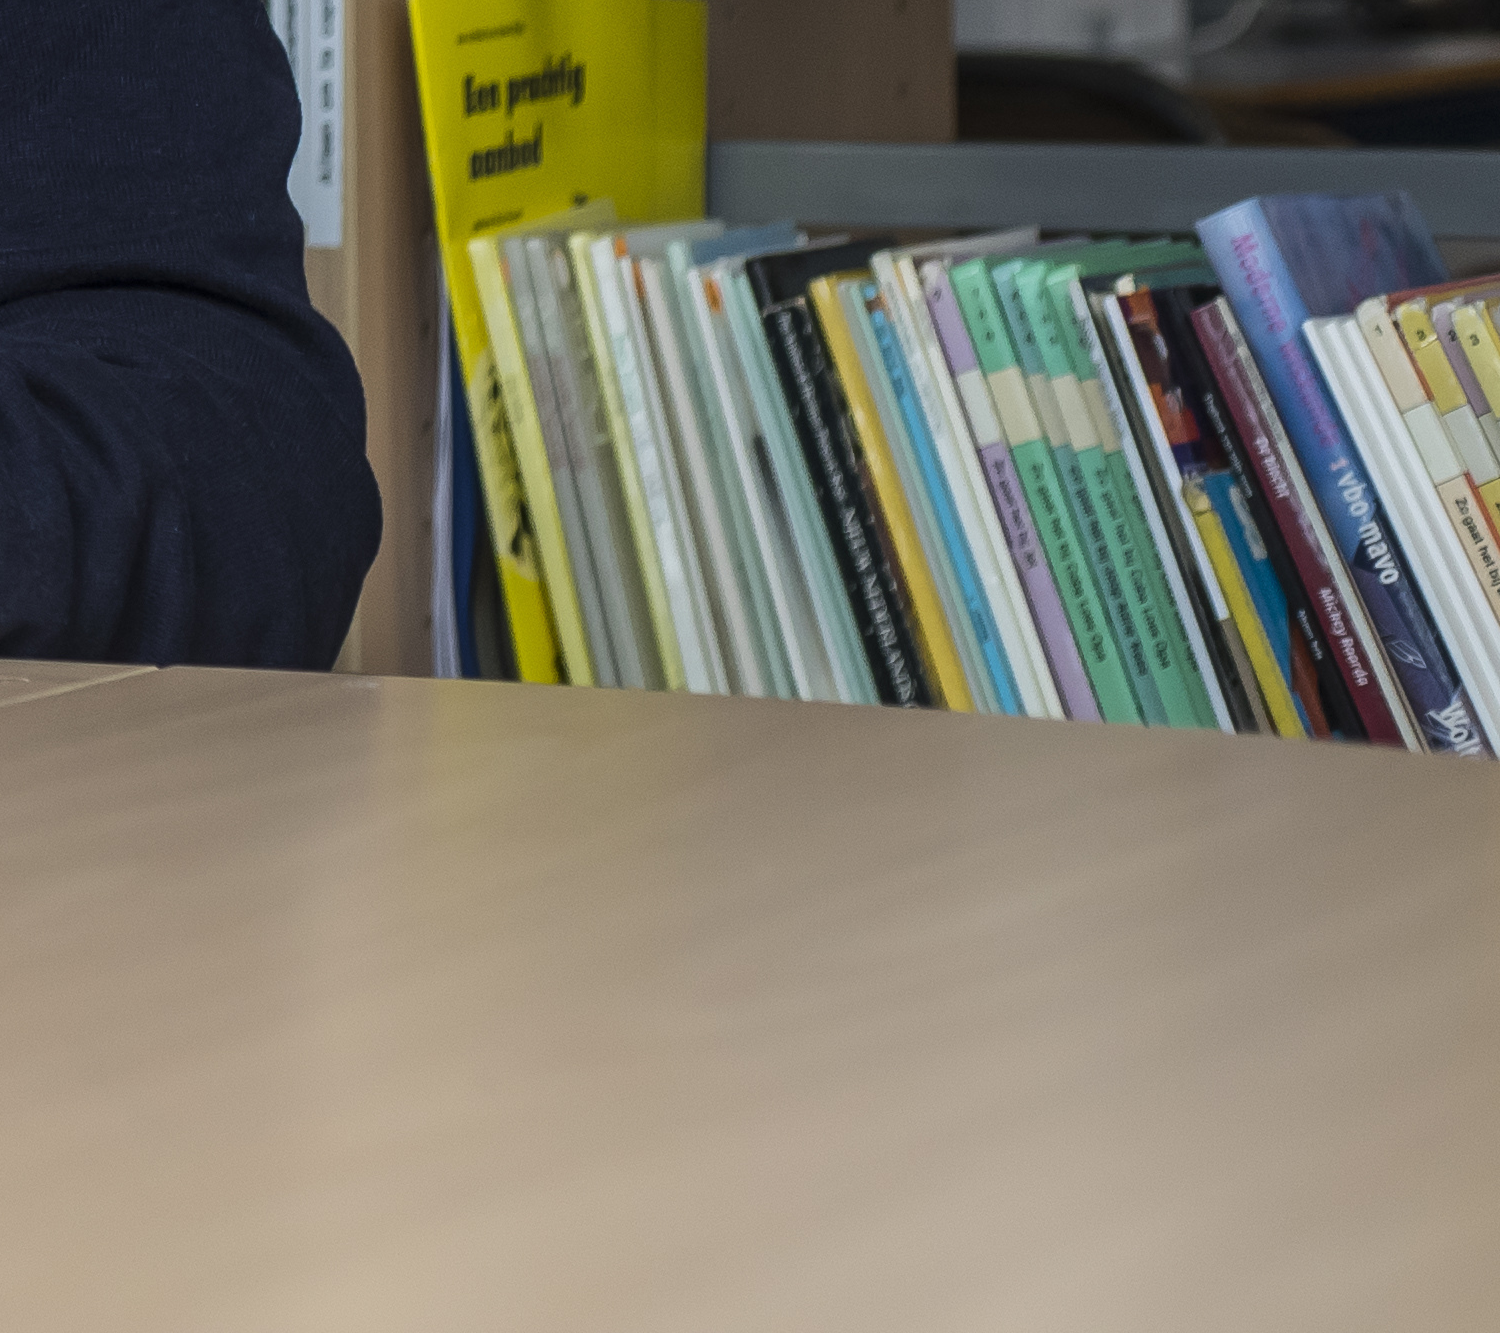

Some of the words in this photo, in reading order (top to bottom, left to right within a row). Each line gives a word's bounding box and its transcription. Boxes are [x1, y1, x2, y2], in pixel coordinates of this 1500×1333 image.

[464, 73, 500, 117] Een
[1334, 468, 1402, 588] vbo-mavo
[1456, 514, 1488, 548] gaat
[1473, 544, 1499, 570] het
